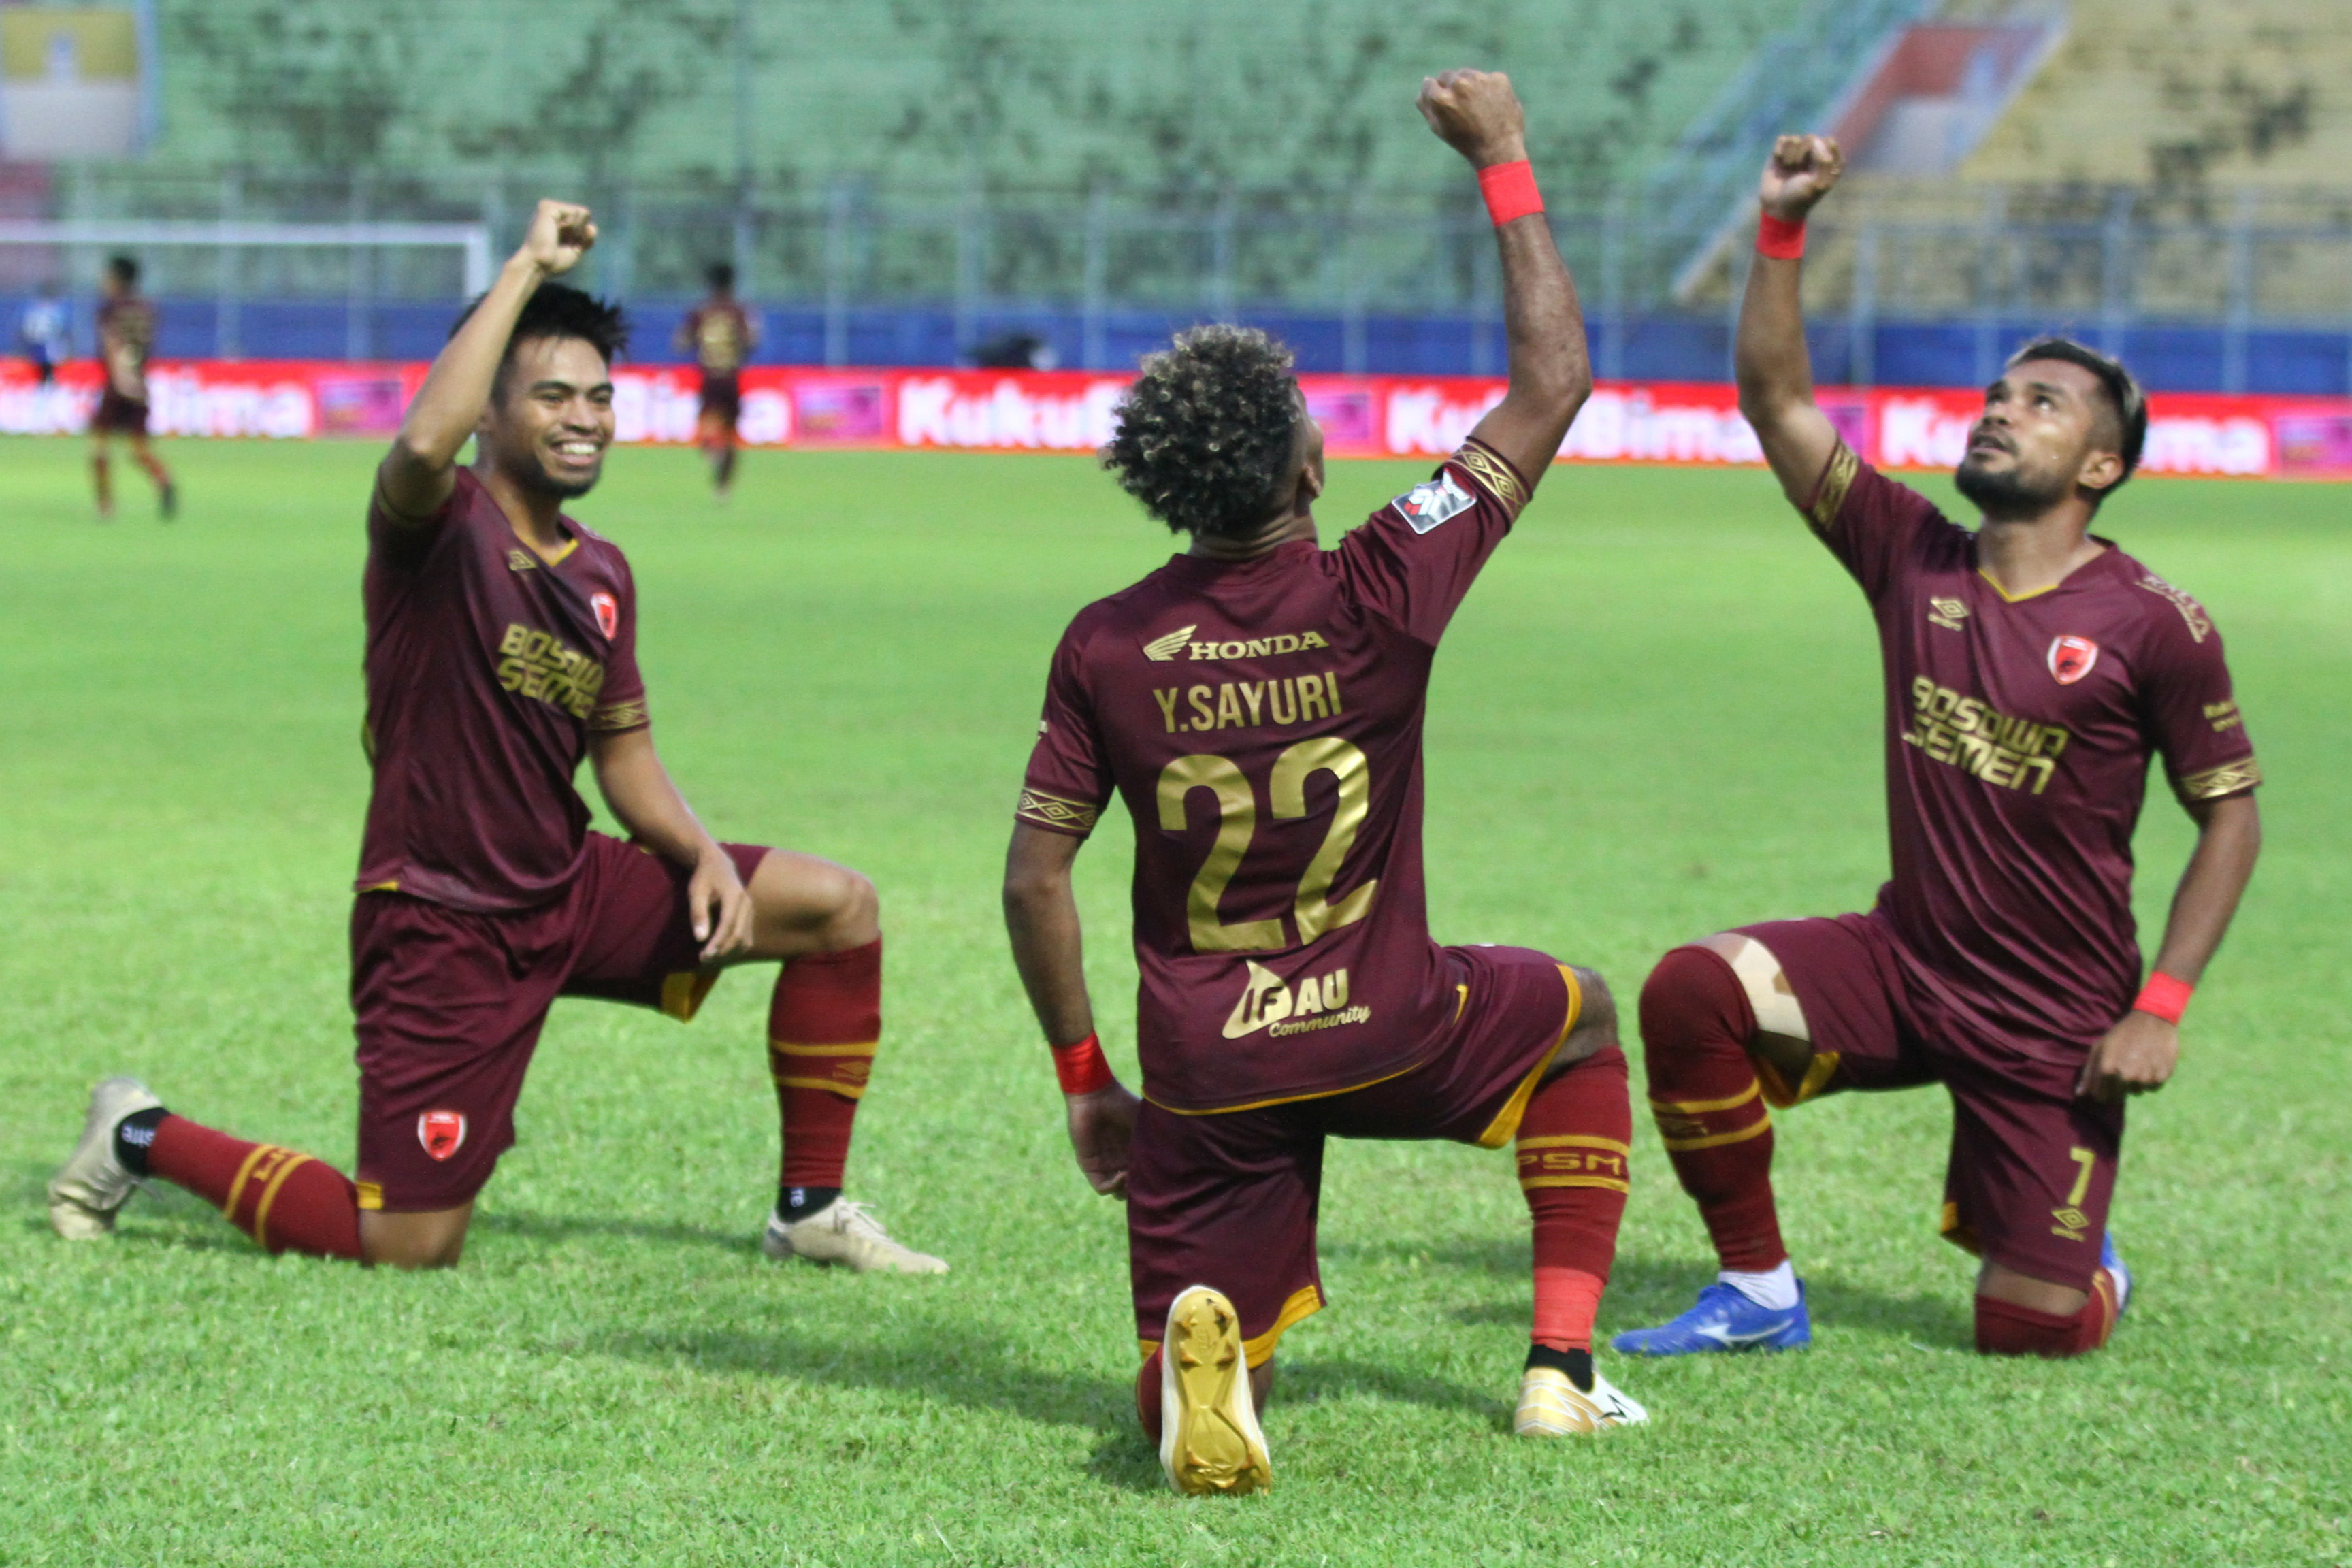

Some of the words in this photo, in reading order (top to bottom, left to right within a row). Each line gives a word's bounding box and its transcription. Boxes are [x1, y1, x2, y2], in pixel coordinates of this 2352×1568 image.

[1189, 631, 1330, 661] HONDA
[1152, 671, 1342, 734] Y.SAYURI
[1156, 736, 1378, 951] 22
[1269, 1006, 1371, 1038] Community
[1517, 1153, 1621, 1176] PSM
[2067, 1146, 2095, 1207] 7
